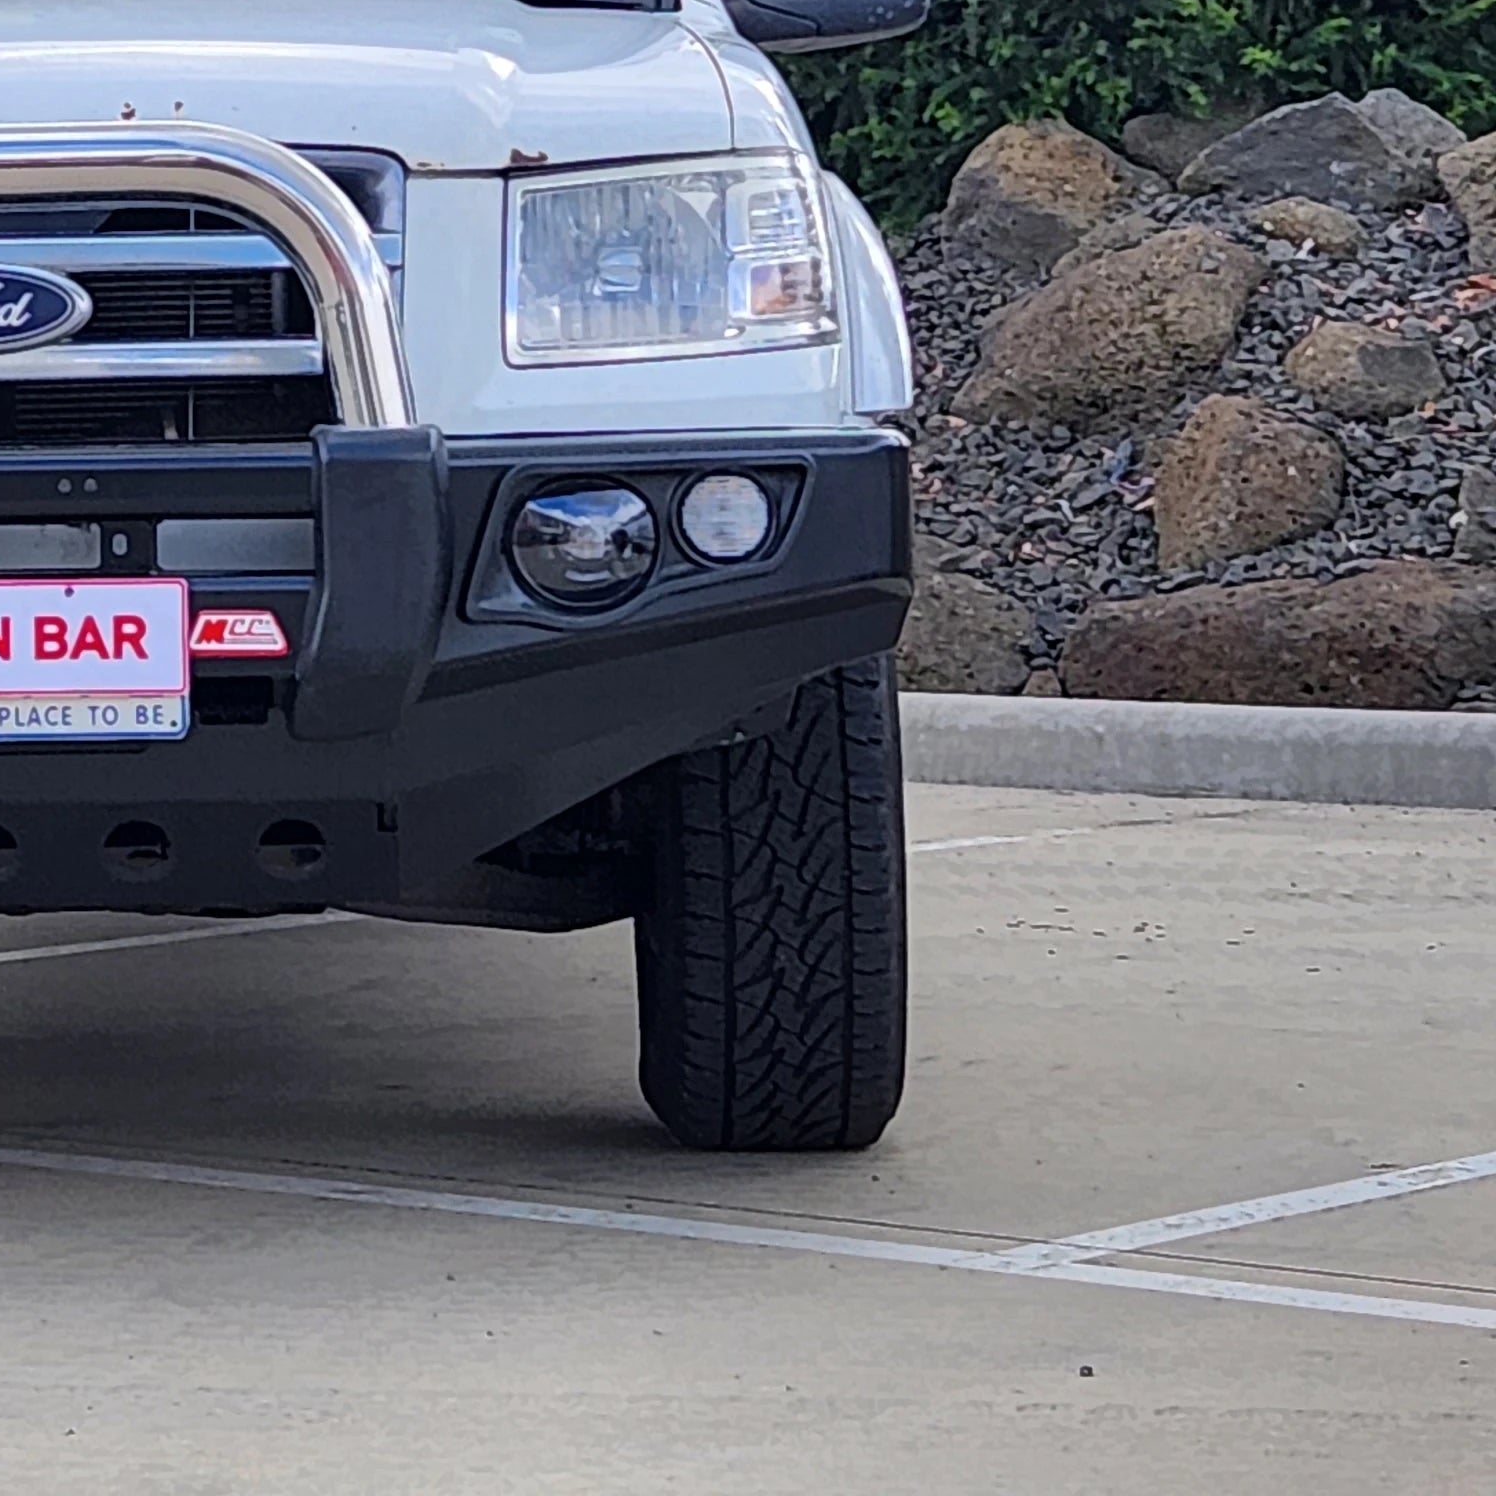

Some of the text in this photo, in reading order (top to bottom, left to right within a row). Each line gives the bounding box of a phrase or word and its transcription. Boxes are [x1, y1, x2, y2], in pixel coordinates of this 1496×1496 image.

[34, 615, 149, 660] BAR
[88, 705, 119, 726] TO
[135, 704, 164, 725] BE
